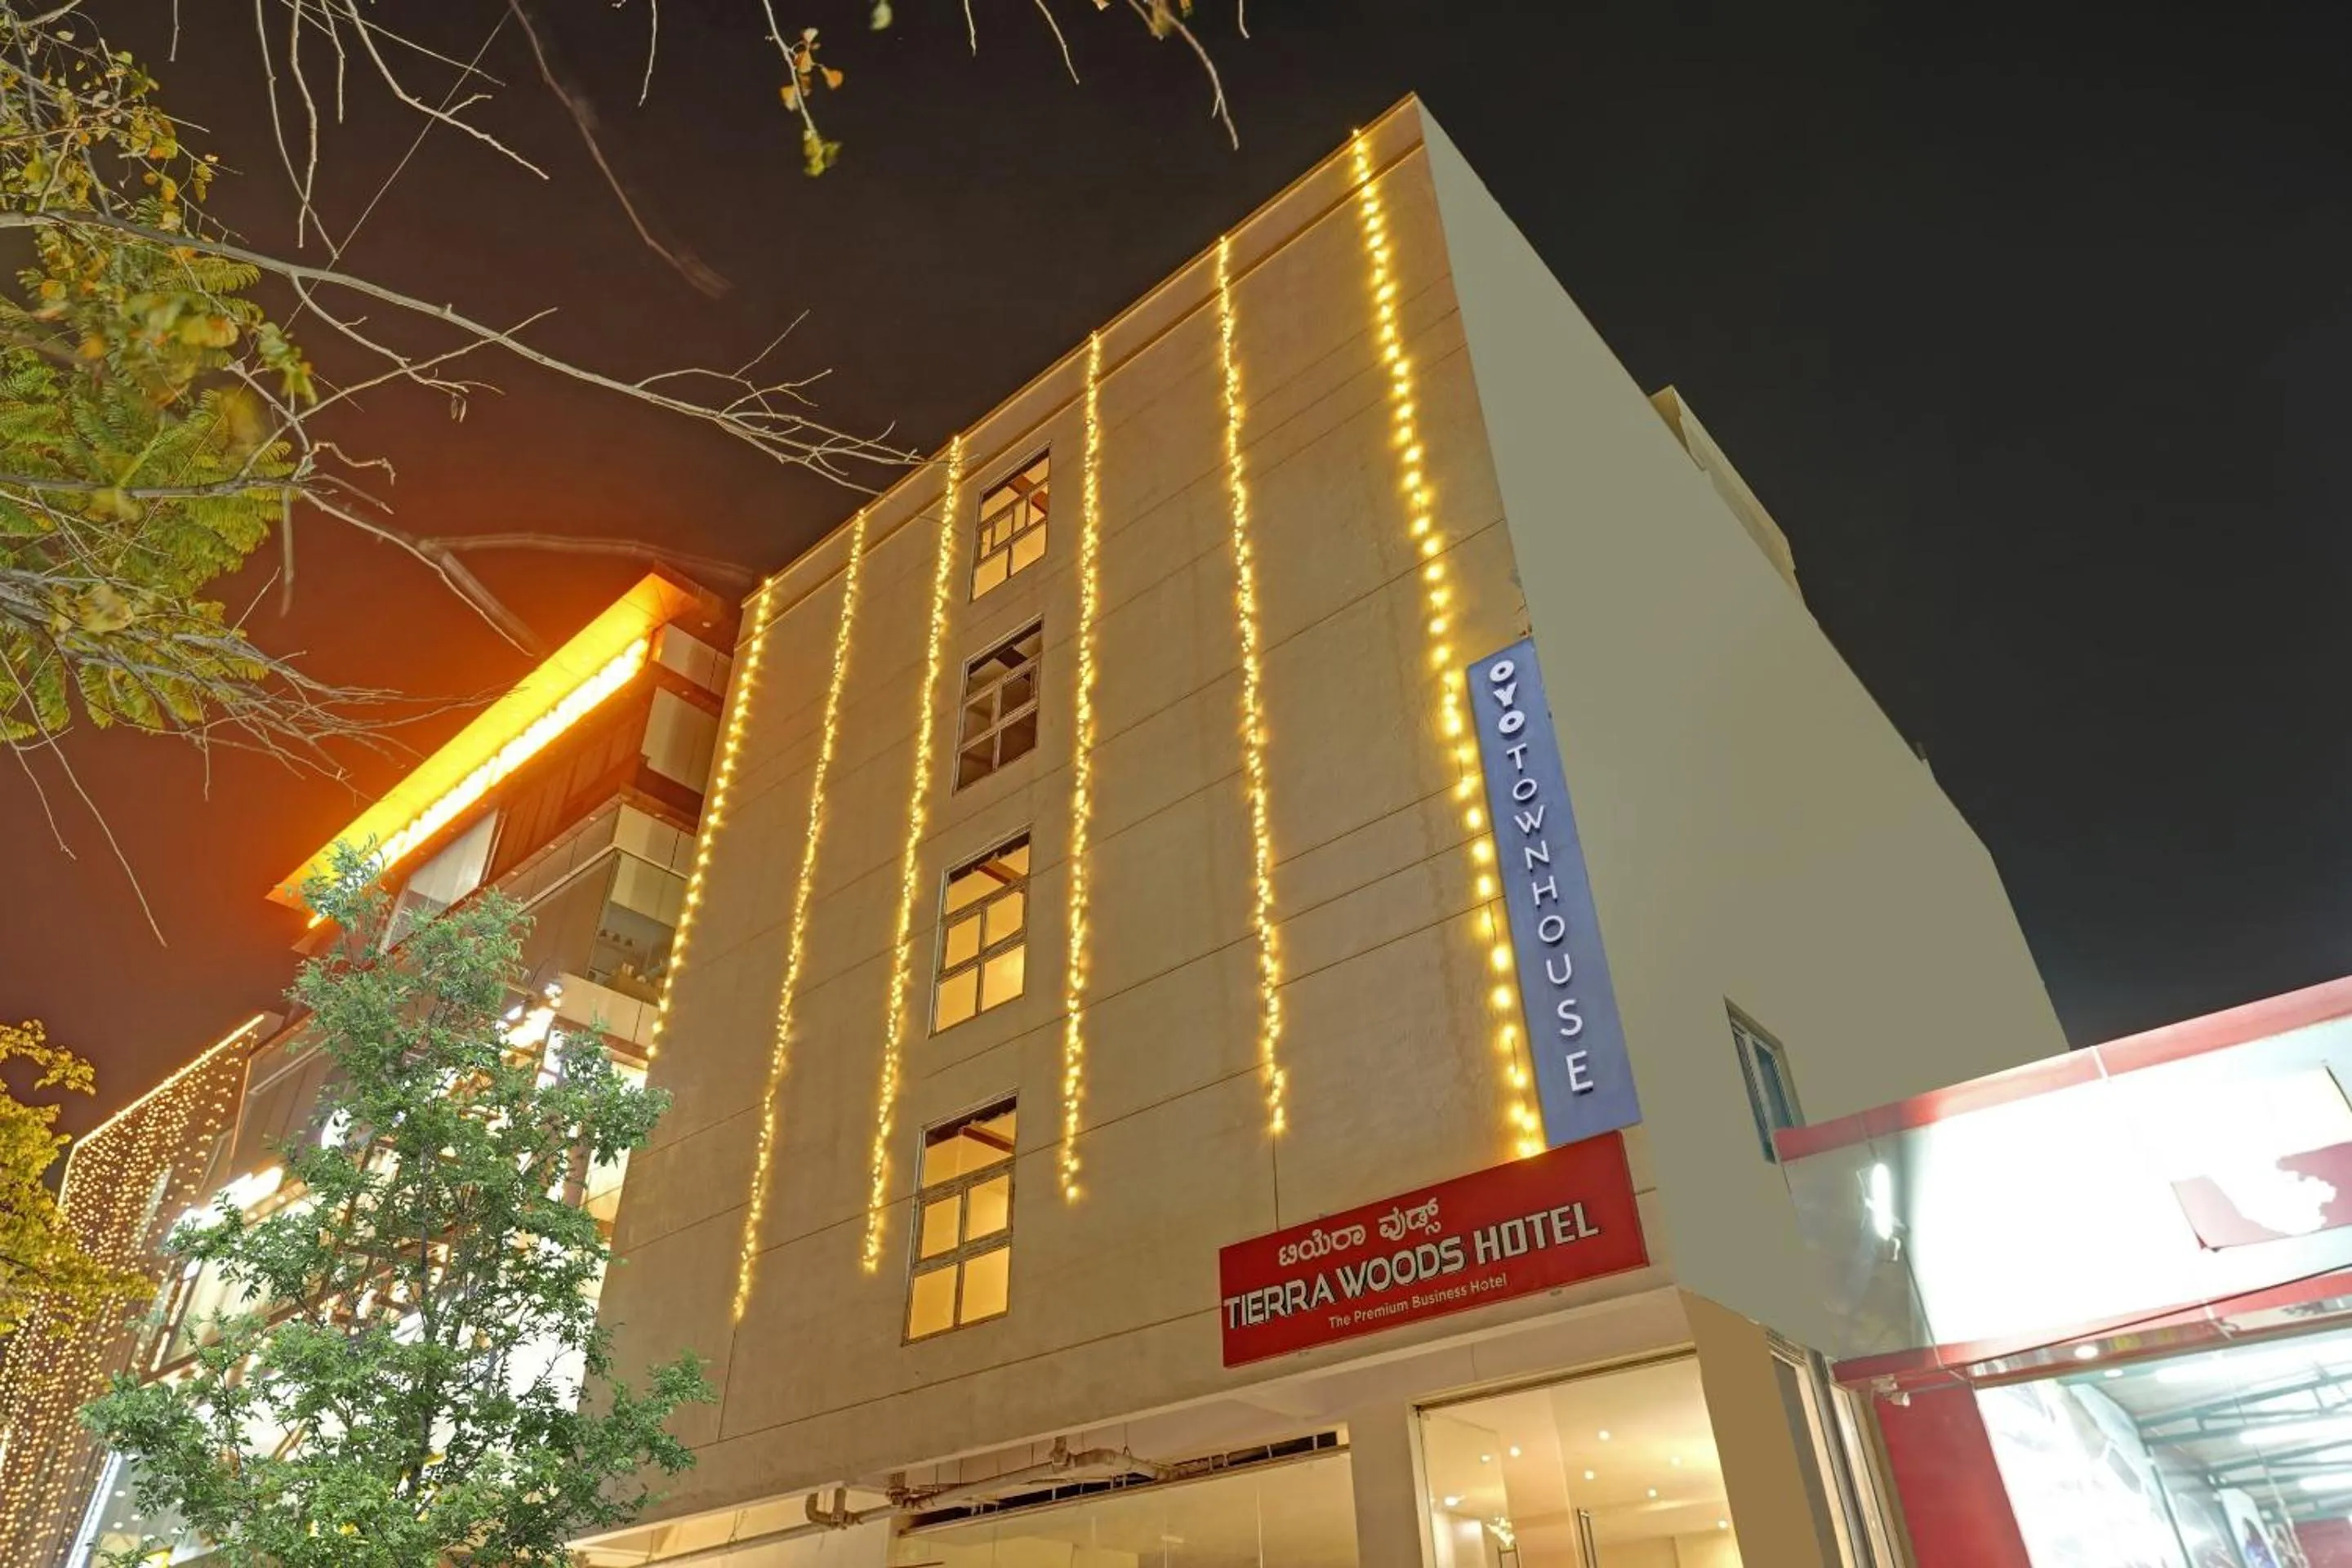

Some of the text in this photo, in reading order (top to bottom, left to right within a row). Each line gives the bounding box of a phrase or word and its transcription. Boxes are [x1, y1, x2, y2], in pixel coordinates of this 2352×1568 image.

[1490, 660, 1525, 733] OYO
[1223, 1202, 1599, 1329] TIERRA WOODS HOTEL
[1329, 1273, 1507, 1329] The Premium Business Hotel
